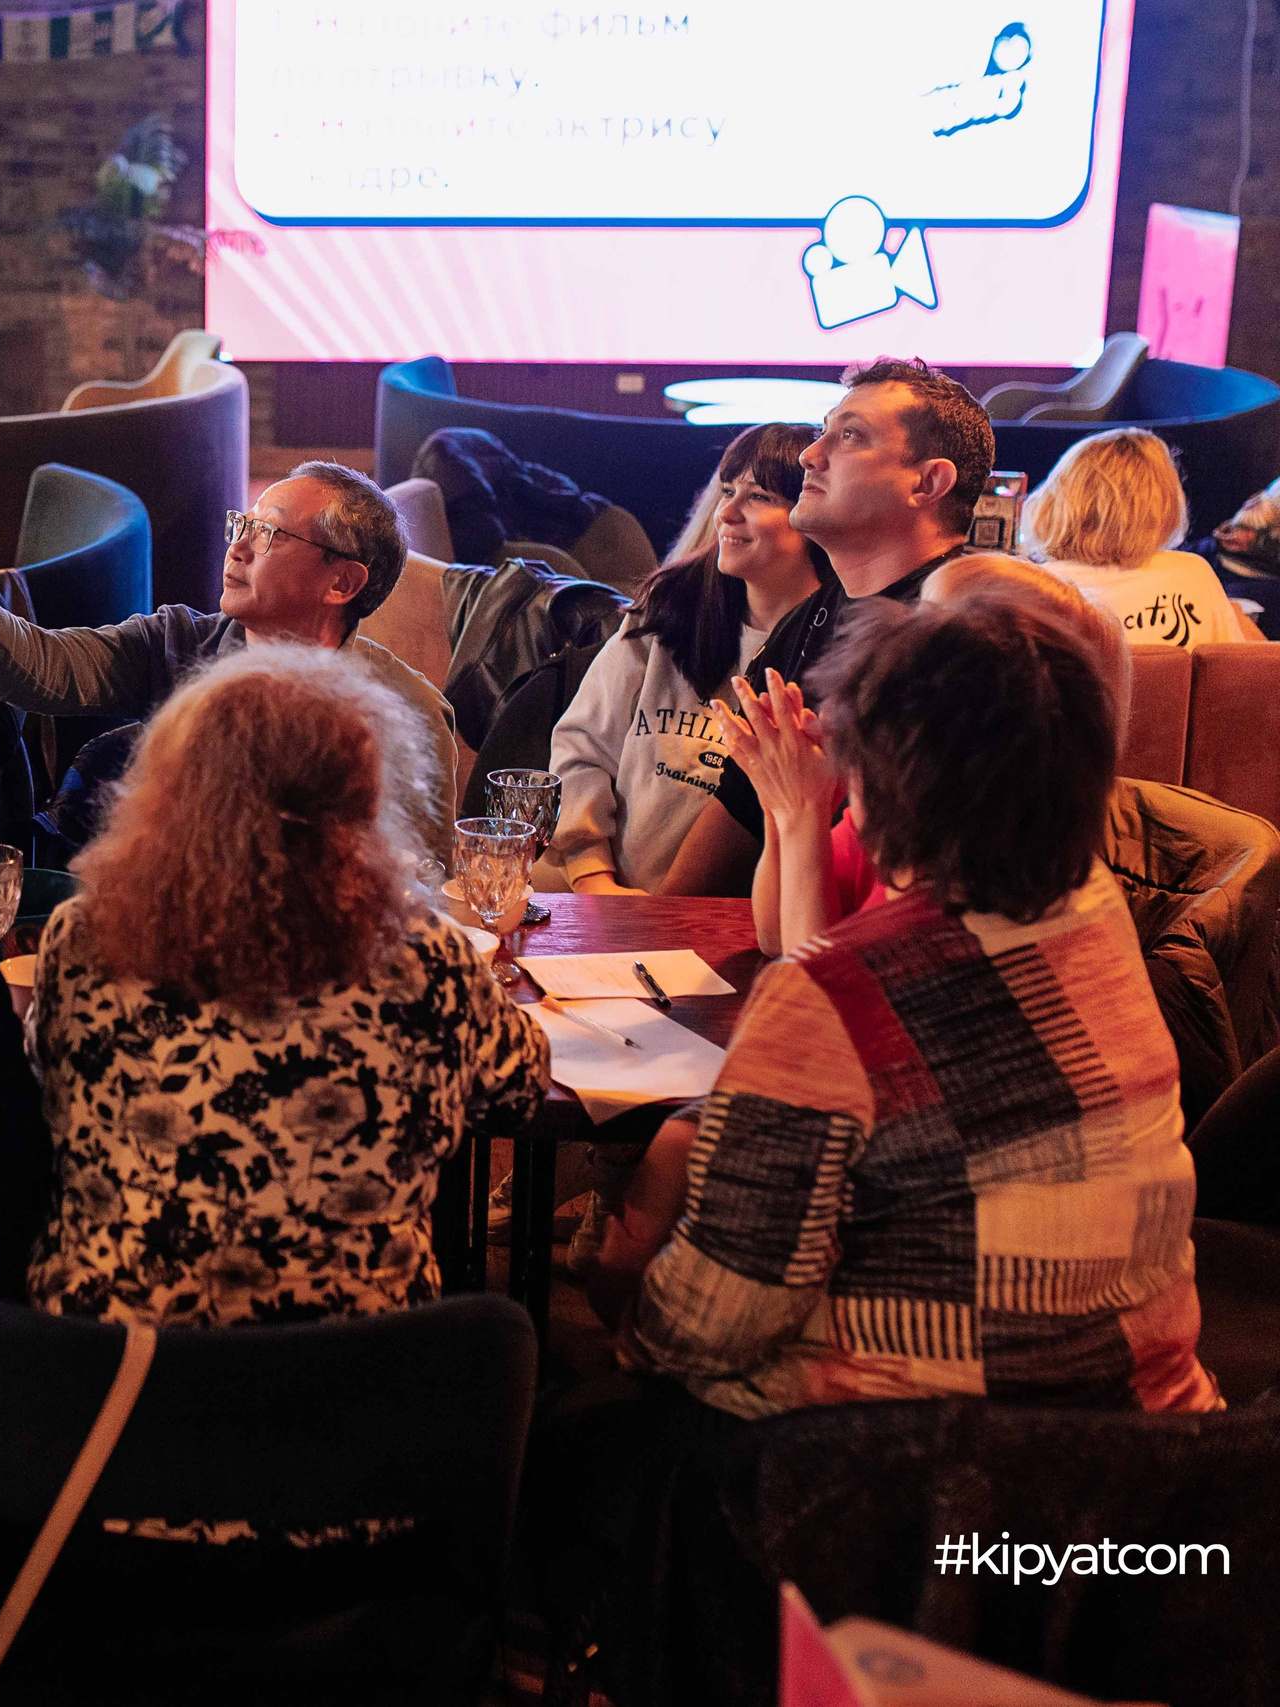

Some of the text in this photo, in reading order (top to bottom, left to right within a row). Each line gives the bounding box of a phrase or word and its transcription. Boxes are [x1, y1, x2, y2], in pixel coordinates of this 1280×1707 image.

[541, 8, 690, 40] фильм
[545, 116, 726, 147] актрису
[635, 708, 725, 745] ATHL
[704, 753, 723, 766] 1958
[655, 762, 720, 796] Training
